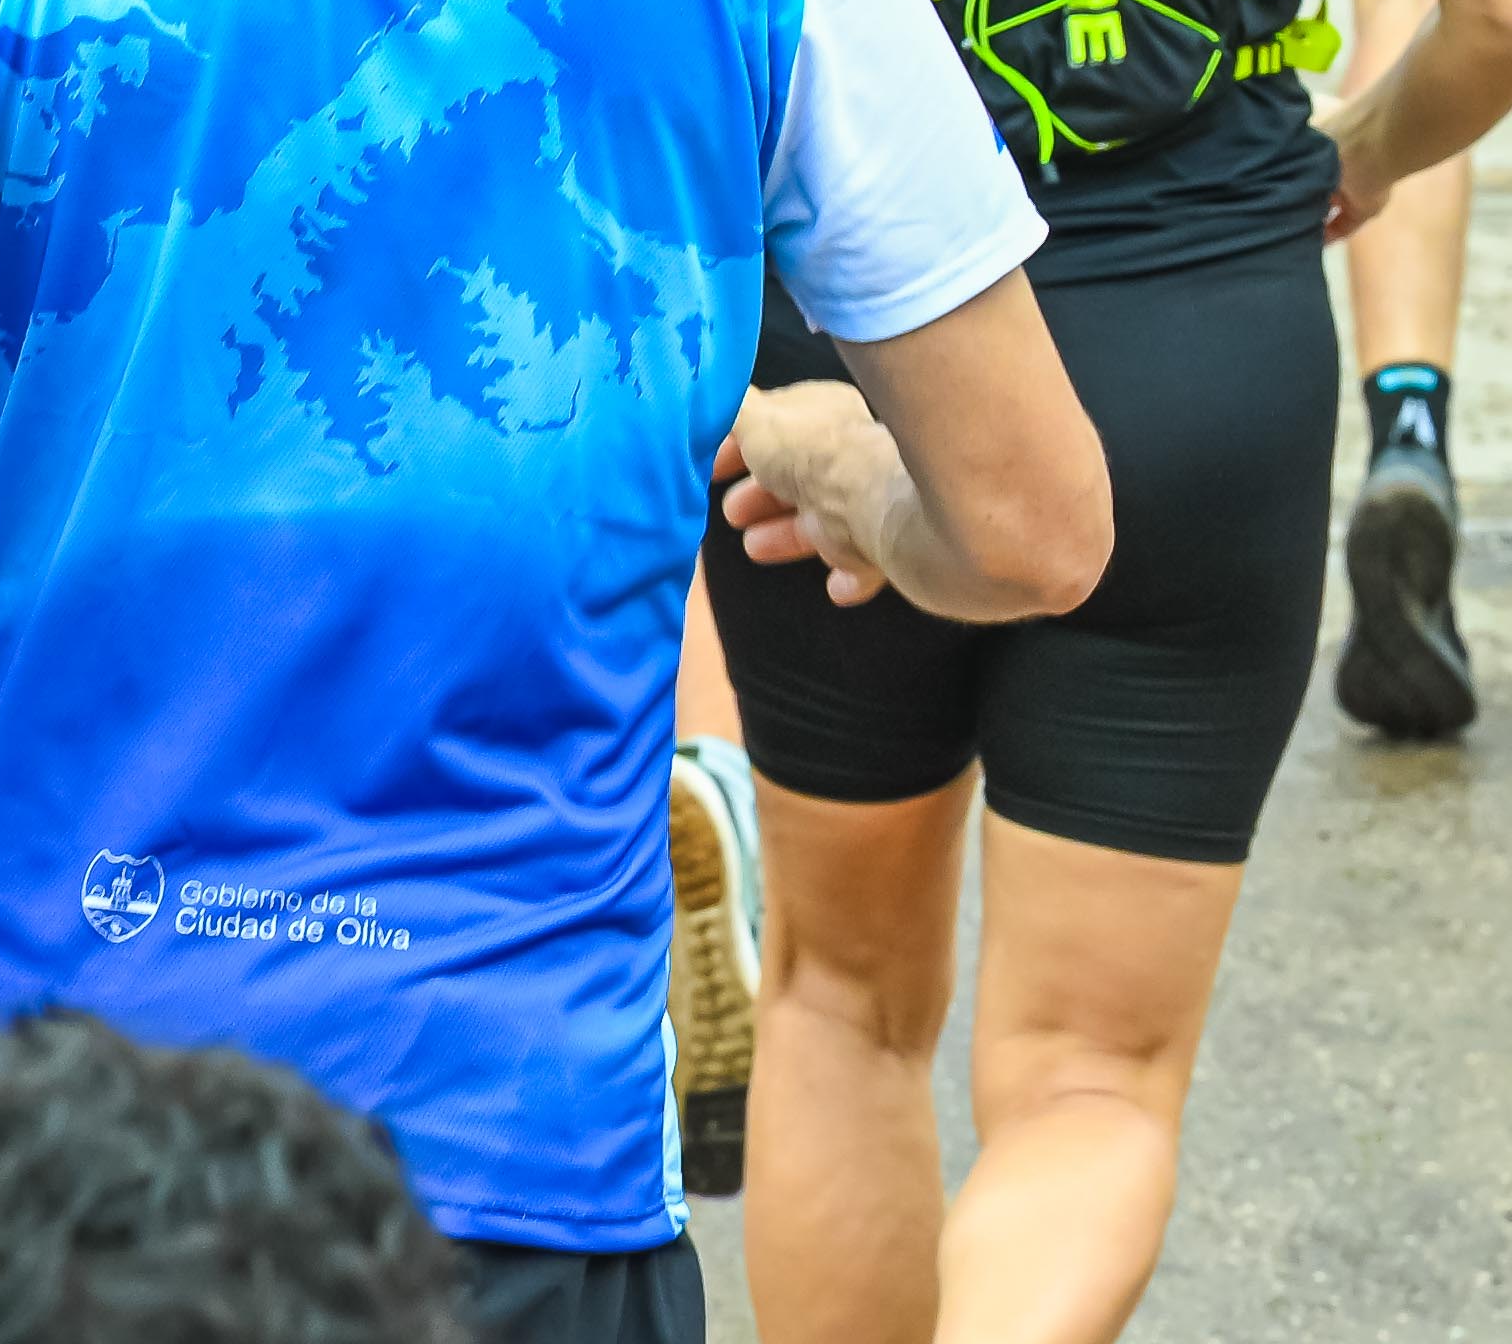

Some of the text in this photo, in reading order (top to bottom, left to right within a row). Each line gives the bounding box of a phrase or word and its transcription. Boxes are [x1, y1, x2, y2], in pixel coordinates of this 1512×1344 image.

[179, 879, 378, 918] Gobierno de la
[175, 906, 411, 952] Ciudad de Oliva
